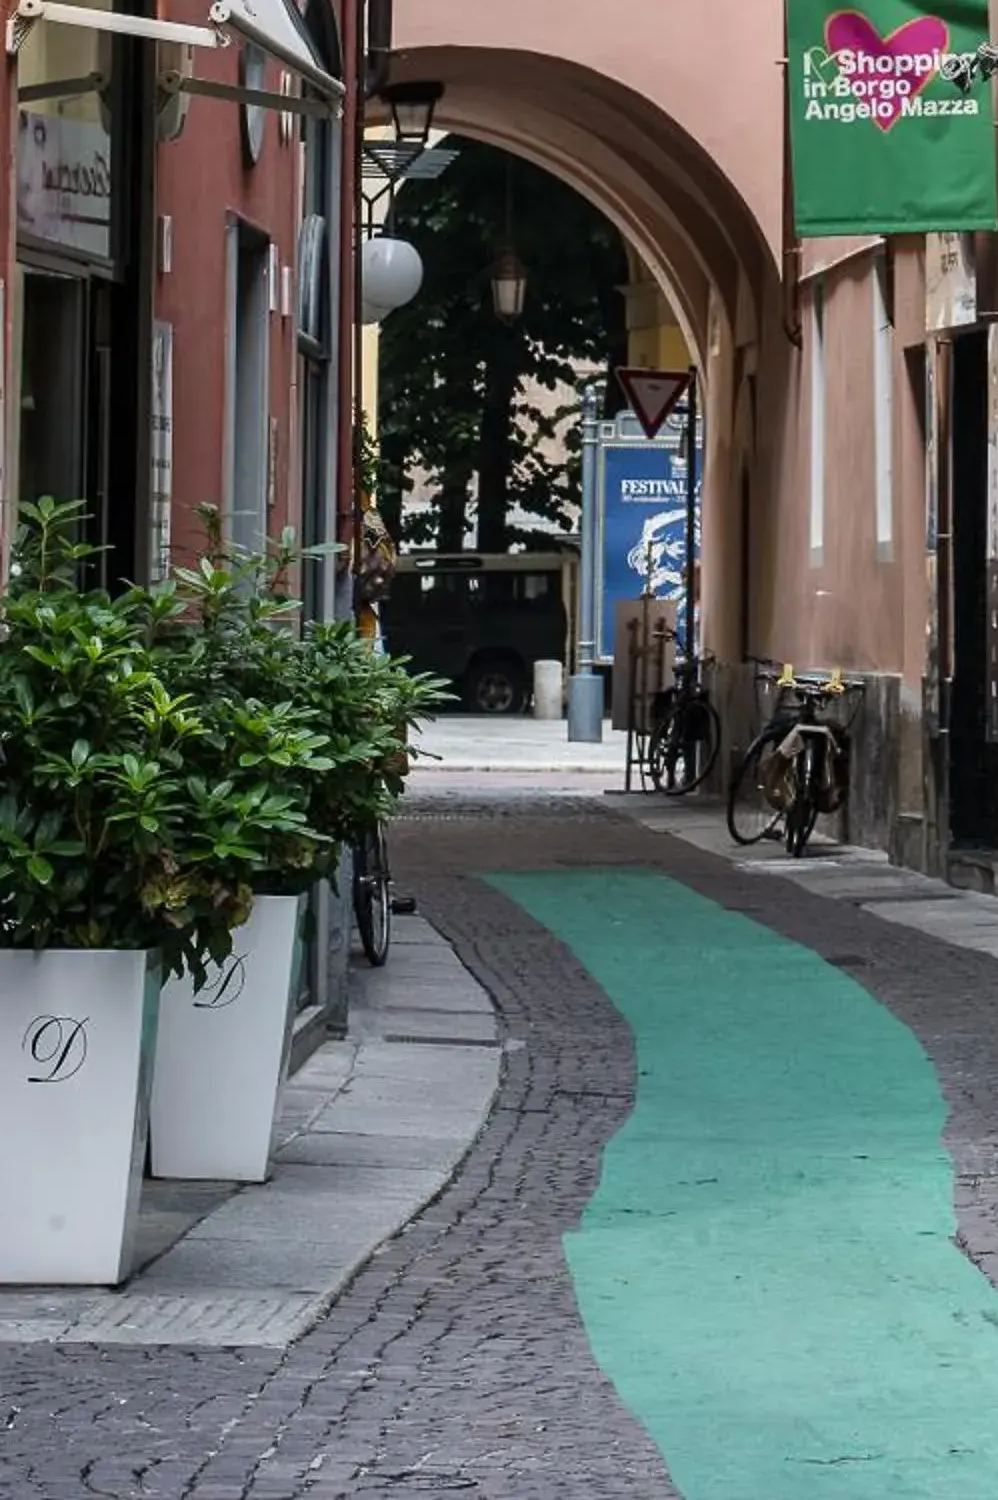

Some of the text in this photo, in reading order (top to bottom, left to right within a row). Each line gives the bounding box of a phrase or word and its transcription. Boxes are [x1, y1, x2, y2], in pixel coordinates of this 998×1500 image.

[803, 76, 911, 99] in Borgo
[804, 97, 979, 122] Angelo Mazza
[621, 479, 689, 495] FESTIVAL
[22, 1014, 91, 1083] D
